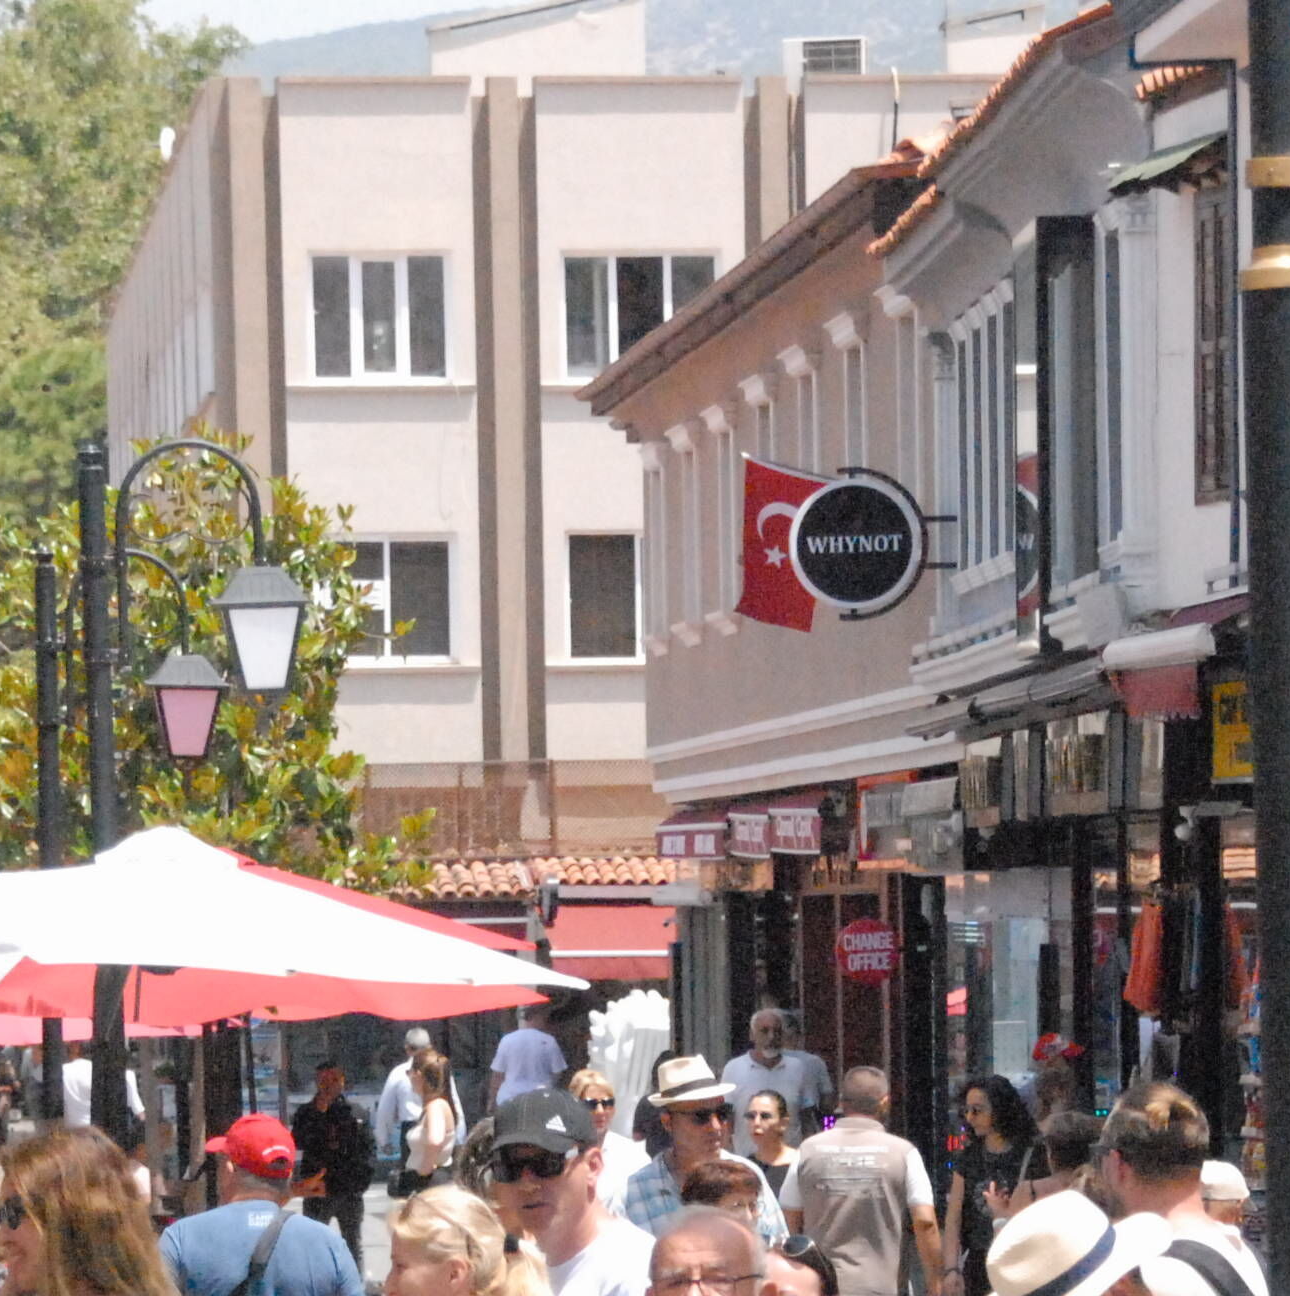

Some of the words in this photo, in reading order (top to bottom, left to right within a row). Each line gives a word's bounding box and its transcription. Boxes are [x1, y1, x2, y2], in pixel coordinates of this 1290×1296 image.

[806, 533, 903, 555] WHYNOT
[844, 931, 894, 952] CHANGE
[848, 951, 892, 972] OFFICE
